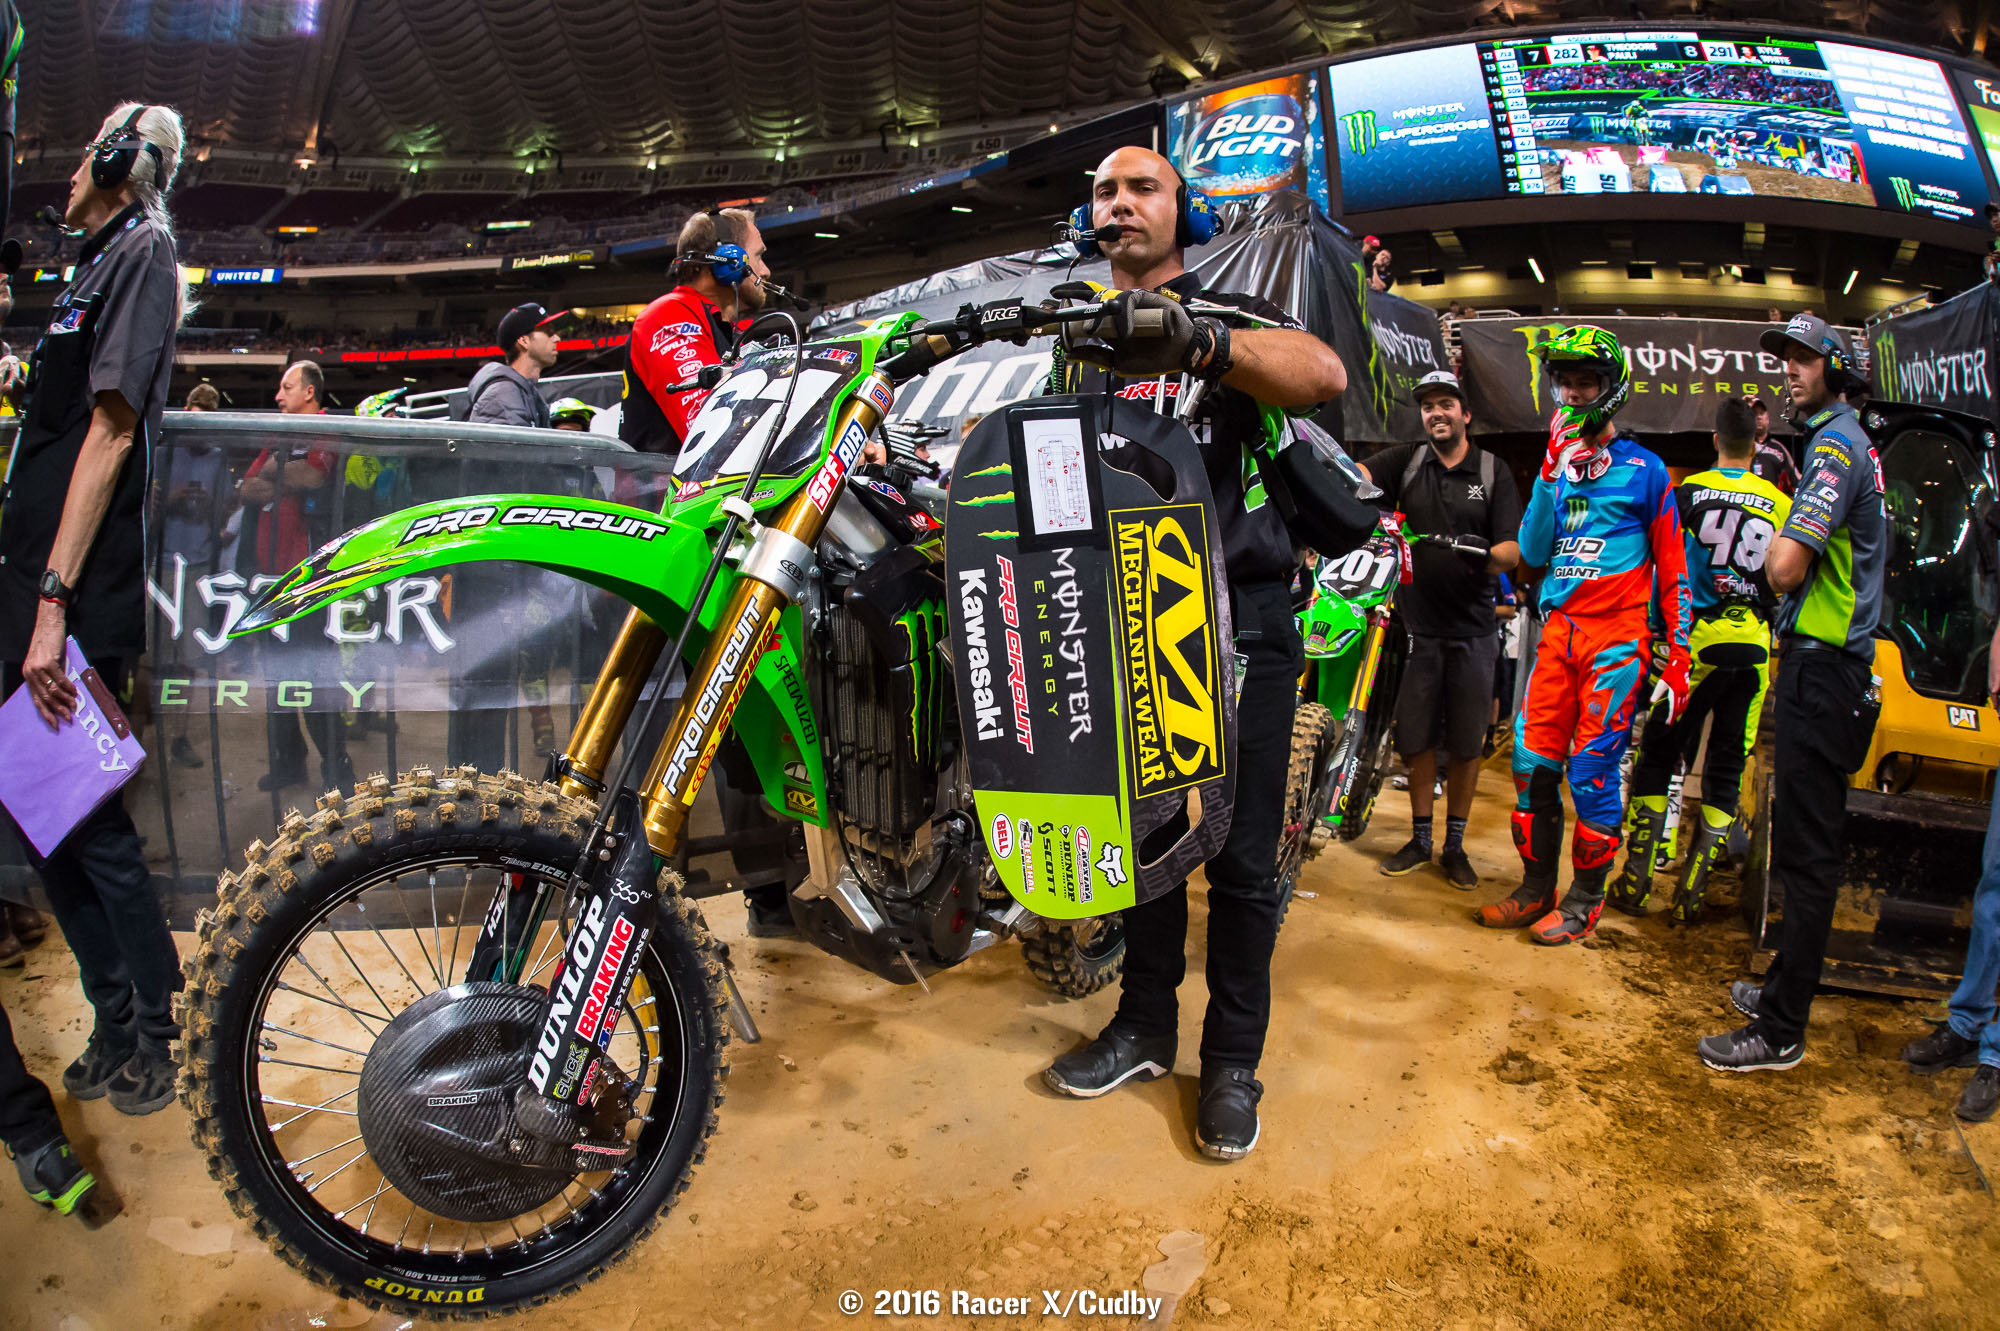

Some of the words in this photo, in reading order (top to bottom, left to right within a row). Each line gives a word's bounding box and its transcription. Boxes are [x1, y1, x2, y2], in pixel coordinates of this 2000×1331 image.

[1482, 52, 1493, 60] 12
[1527, 50, 1539, 62] 7
[1553, 49, 1579, 59] 282
[1684, 45, 1698, 58] 8
[1710, 46, 1734, 57] 291
[1757, 46, 1782, 55] KYLE
[1761, 55, 1791, 65] WHITE
[1485, 64, 1496, 72] 13
[1488, 76, 1499, 84] 14
[1490, 88, 1502, 96] 15
[1493, 101, 1505, 109] 16
[1206, 113, 1295, 141] BUD
[1496, 113, 1507, 122] 17
[1378, 118, 1490, 141] SUPERCROSS
[1498, 127, 1510, 135] 18
[976, 138, 1001, 151] 450
[1188, 134, 1301, 167] LIGHT
[1500, 140, 1513, 149] 19
[1502, 154, 1516, 163] 20
[1505, 168, 1518, 177] 21
[1507, 182, 1520, 192] 22
[705, 254, 728, 262] LAROCCO
[216, 271, 260, 281] UNITED
[980, 307, 1021, 324] ARC
[1899, 347, 1992, 404] MONSTER
[1634, 381, 1783, 396] ENERGY
[806, 458, 844, 514] SFF
[836, 423, 866, 468] AIR
[1692, 489, 1775, 513] RODRIGUEZ
[400, 505, 499, 544] PRO
[500, 505, 669, 542] CIRCUIT
[1700, 509, 1777, 572] 48
[1553, 567, 1601, 580] GIANT
[996, 554, 1020, 629] PRO
[1116, 519, 1149, 690] MECHANIX
[958, 567, 1005, 742] Kawasaki
[1033, 579, 1060, 717] ENERGY
[1050, 547, 1093, 744] MONSTER
[717, 620, 774, 736] SHOWA
[660, 715, 704, 797] PRO
[694, 594, 762, 726] CIRCUIT
[773, 654, 817, 746] SPECIALIZED
[1004, 627, 1035, 756] CIRCUIT
[1949, 705, 1976, 729] CAT
[1132, 689, 1167, 788] WEAR
[1344, 756, 1360, 796] GIBSON
[996, 819, 1009, 859] BELL
[531, 861, 568, 882] EXCEL
[1023, 839, 1035, 895] RENTHAL
[1042, 836, 1057, 897] SCOTT
[1063, 840, 1076, 902] DUNLOP
[610, 878, 640, 905] 360
[640, 889, 653, 900] FLY
[574, 914, 636, 1043] BRAKING
[615, 927, 650, 1010] PISTONS
[527, 894, 605, 1096] DUNLOP
[428, 1095, 477, 1107] BRAKING
[571, 1143, 595, 1152] PRO
[425, 1273, 458, 1283] EXCEL
[364, 1276, 486, 1304] DUNLOP
